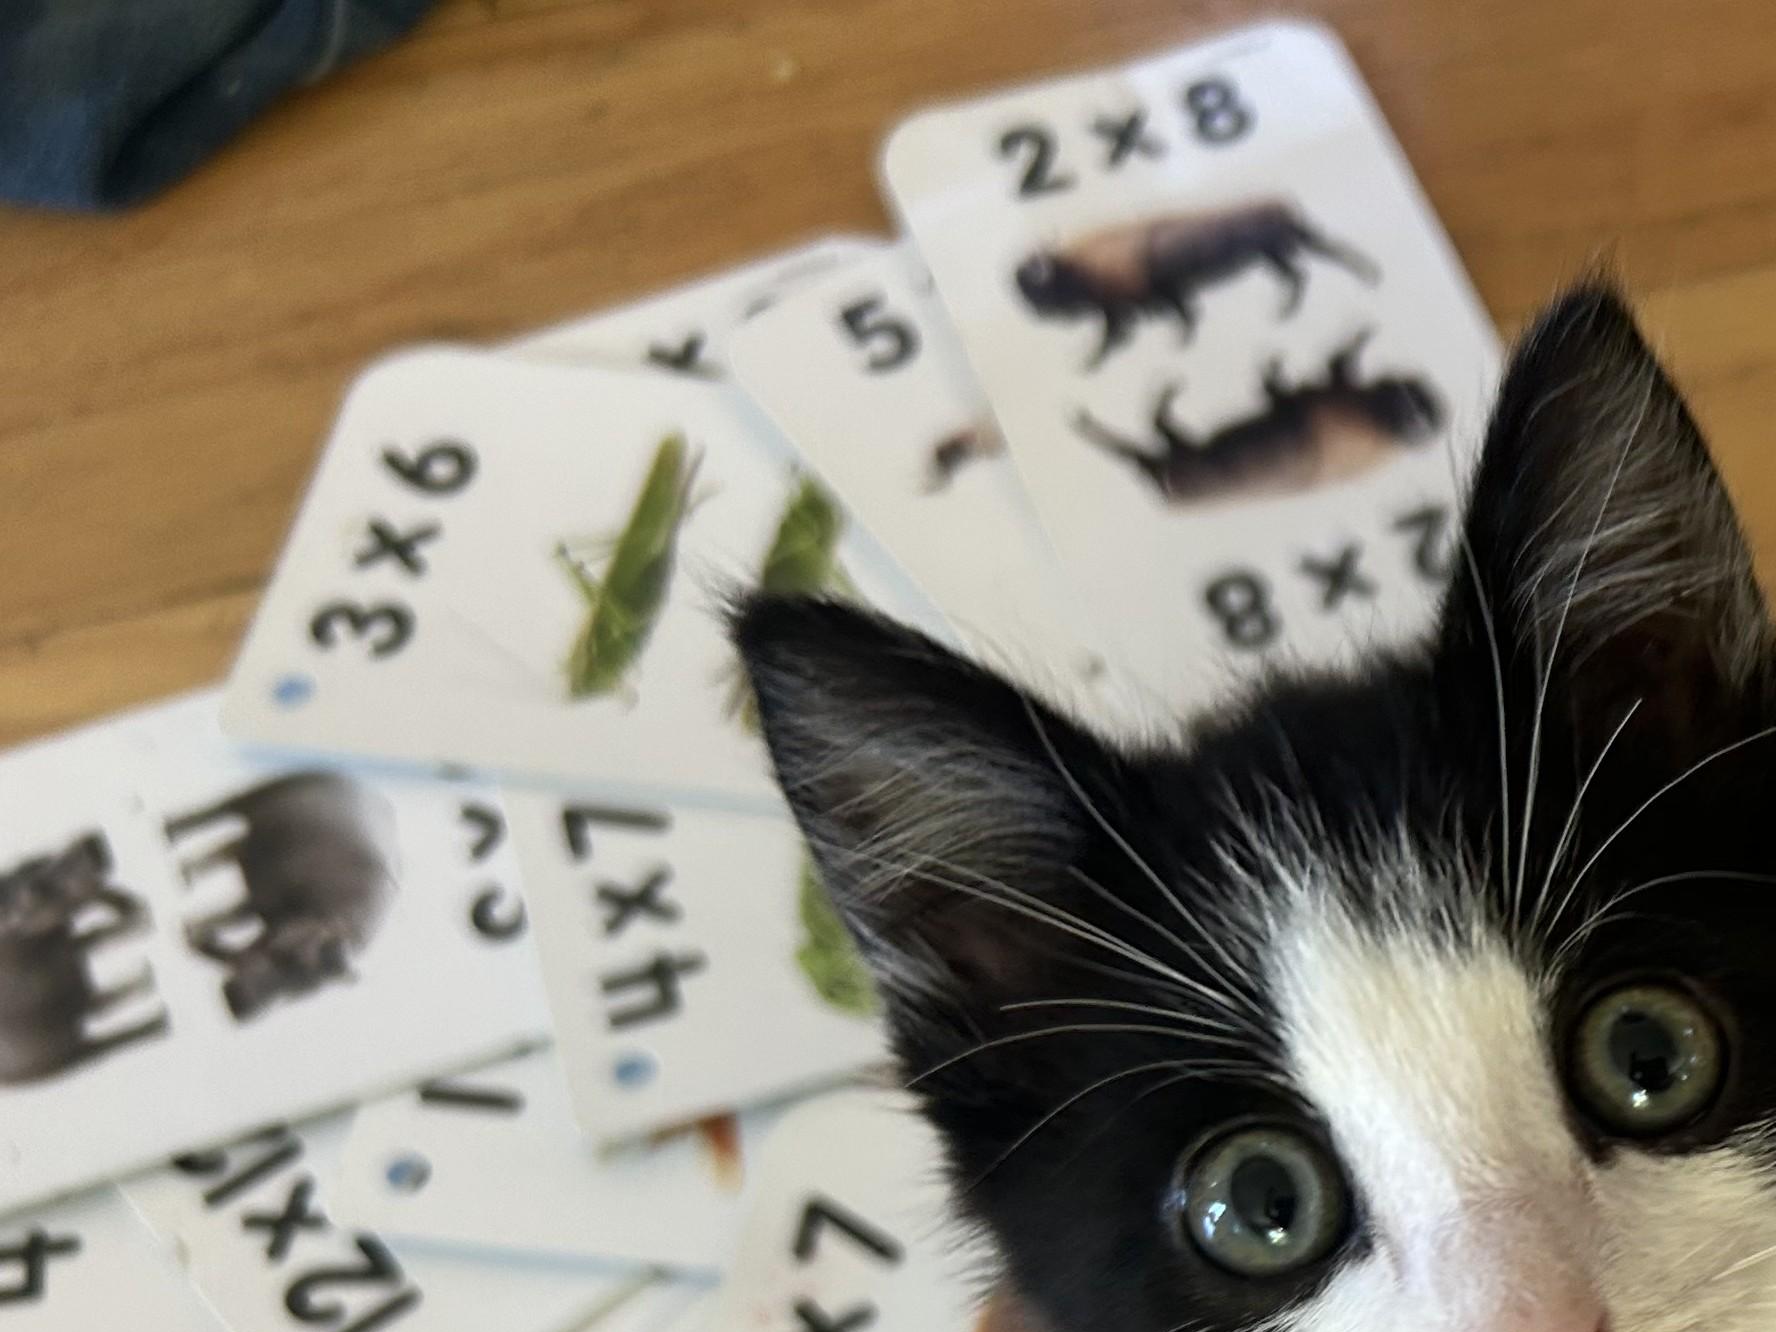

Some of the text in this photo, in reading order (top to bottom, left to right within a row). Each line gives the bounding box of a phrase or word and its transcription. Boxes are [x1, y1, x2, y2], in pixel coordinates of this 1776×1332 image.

[997, 75, 1255, 199] 2 x 8
[837, 297, 919, 374] 5
[309, 441, 477, 658] 3 x 6
[1301, 545, 1374, 610] x
[1203, 570, 1281, 648] 8
[558, 801, 703, 1030] 4 x 7
[243, 1175, 328, 1263] x
[790, 1197, 901, 1264] 7
